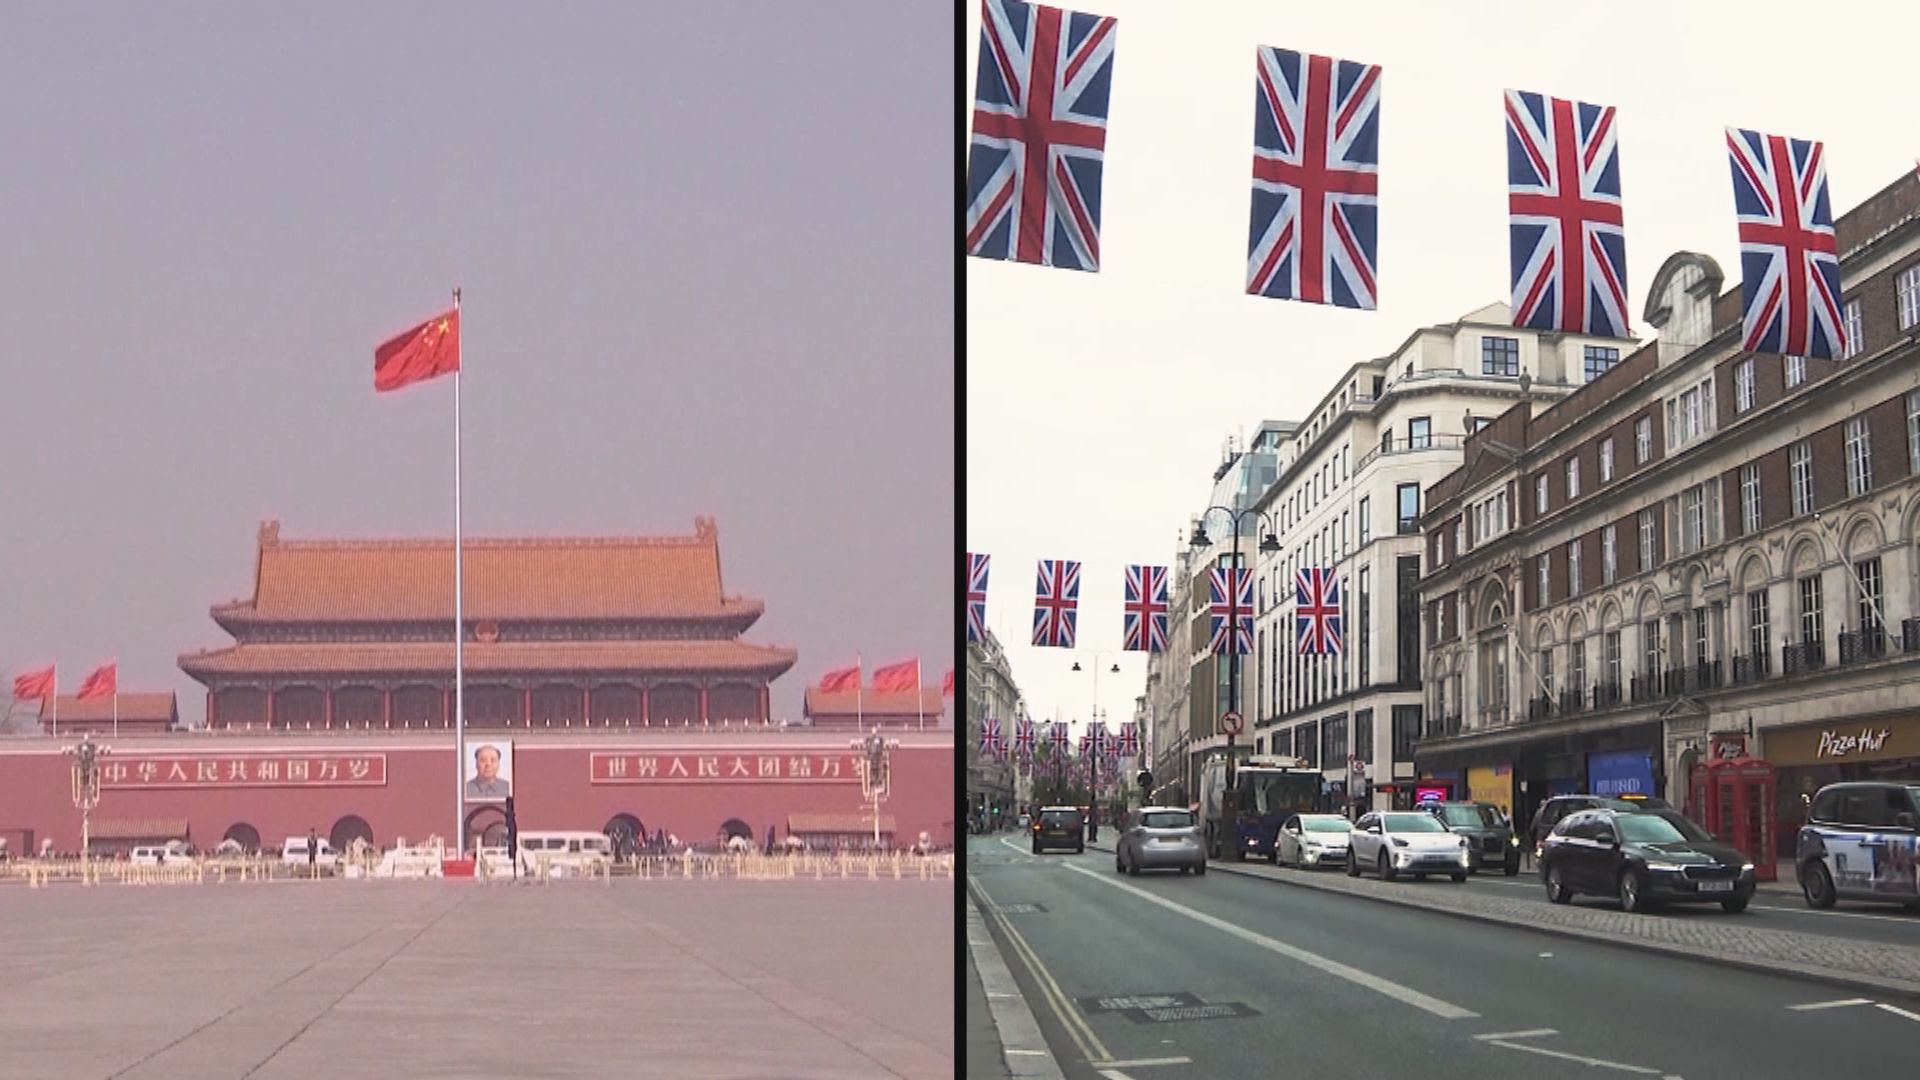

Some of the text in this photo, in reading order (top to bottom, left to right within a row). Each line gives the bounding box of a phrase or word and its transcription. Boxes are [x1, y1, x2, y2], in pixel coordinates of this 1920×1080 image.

[1818, 728, 1891, 758] Pizza Hut
[105, 760, 370, 781] 中华人民共和国万岁
